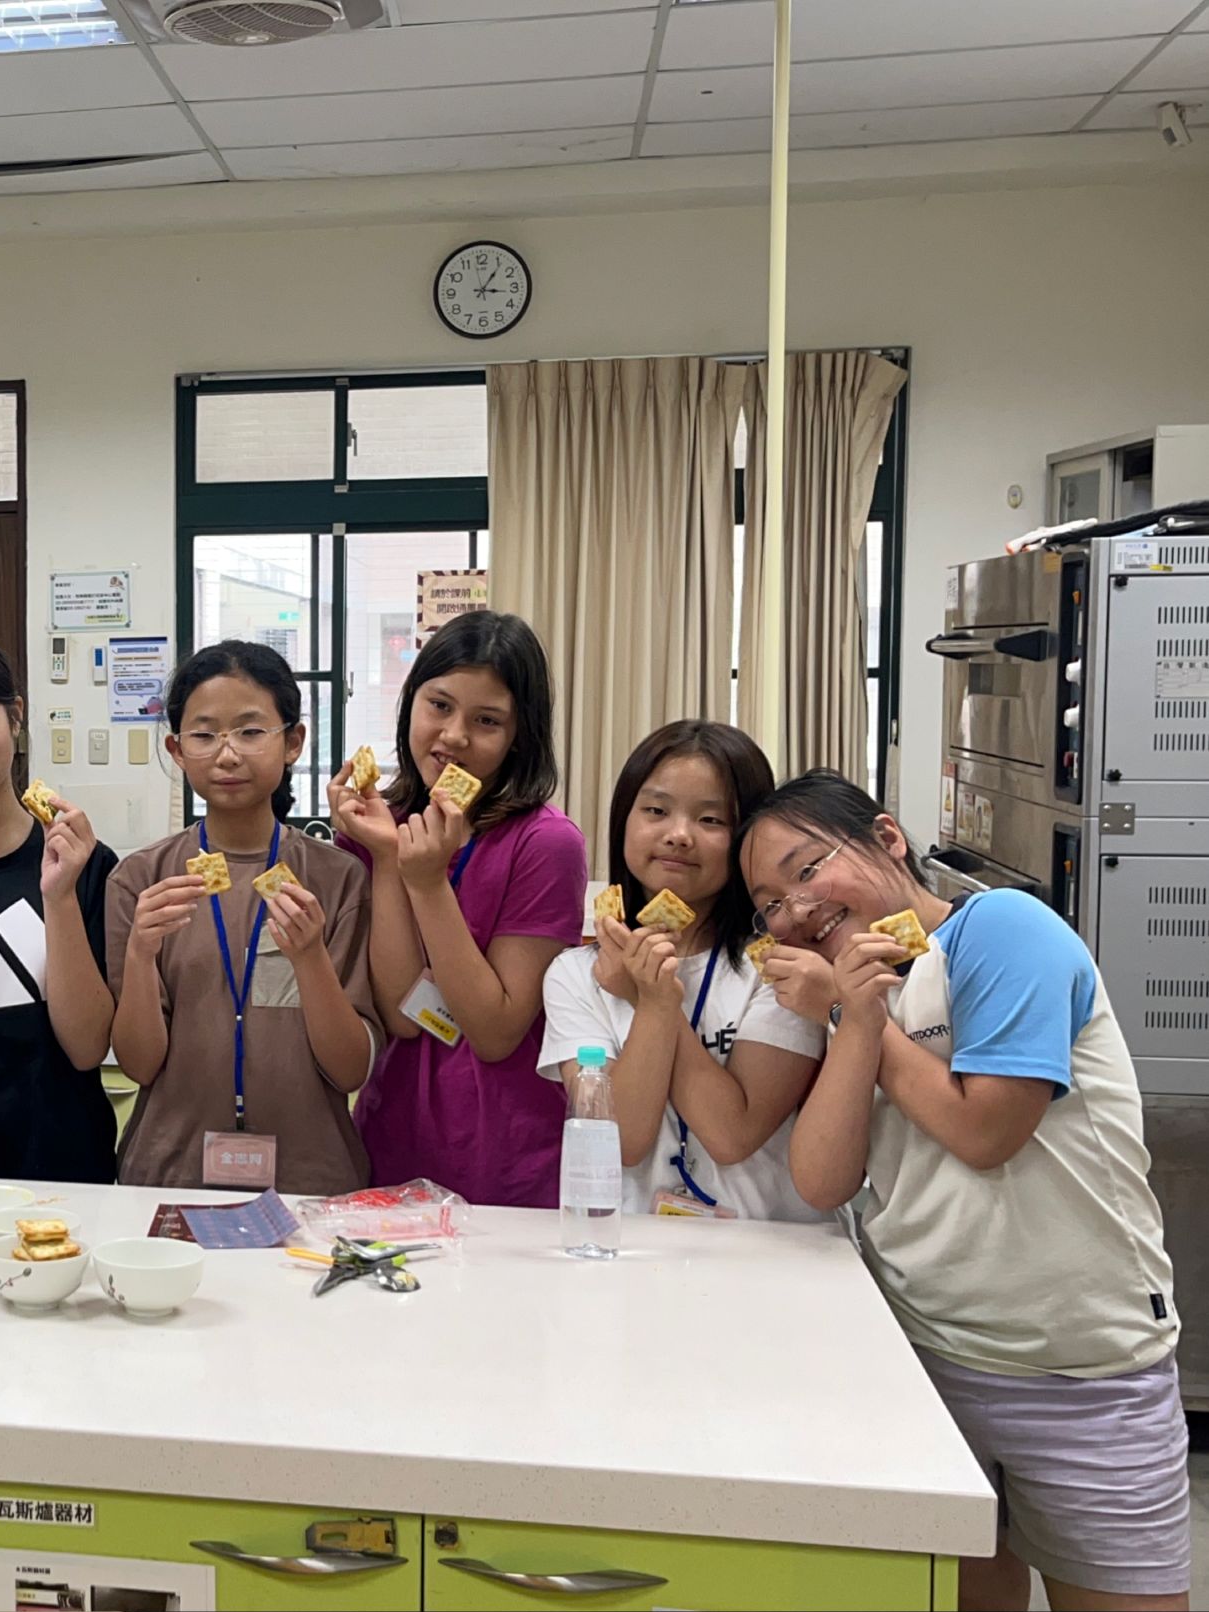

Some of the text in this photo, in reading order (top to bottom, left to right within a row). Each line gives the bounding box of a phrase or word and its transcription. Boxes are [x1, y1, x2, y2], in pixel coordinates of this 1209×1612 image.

[461, 260, 470, 270] 11
[476, 254, 488, 265] 12
[450, 272, 463, 283] 10
[505, 267, 514, 278] 2
[510, 282, 519, 293] 3
[446, 288, 456, 299] 9
[452, 304, 461, 315] 8
[506, 299, 515, 309] 4
[464, 314, 473, 325] 7
[479, 316, 489, 327] 6
[494, 311, 504, 322] 5
[909, 1024, 949, 1041] UTDOOR
